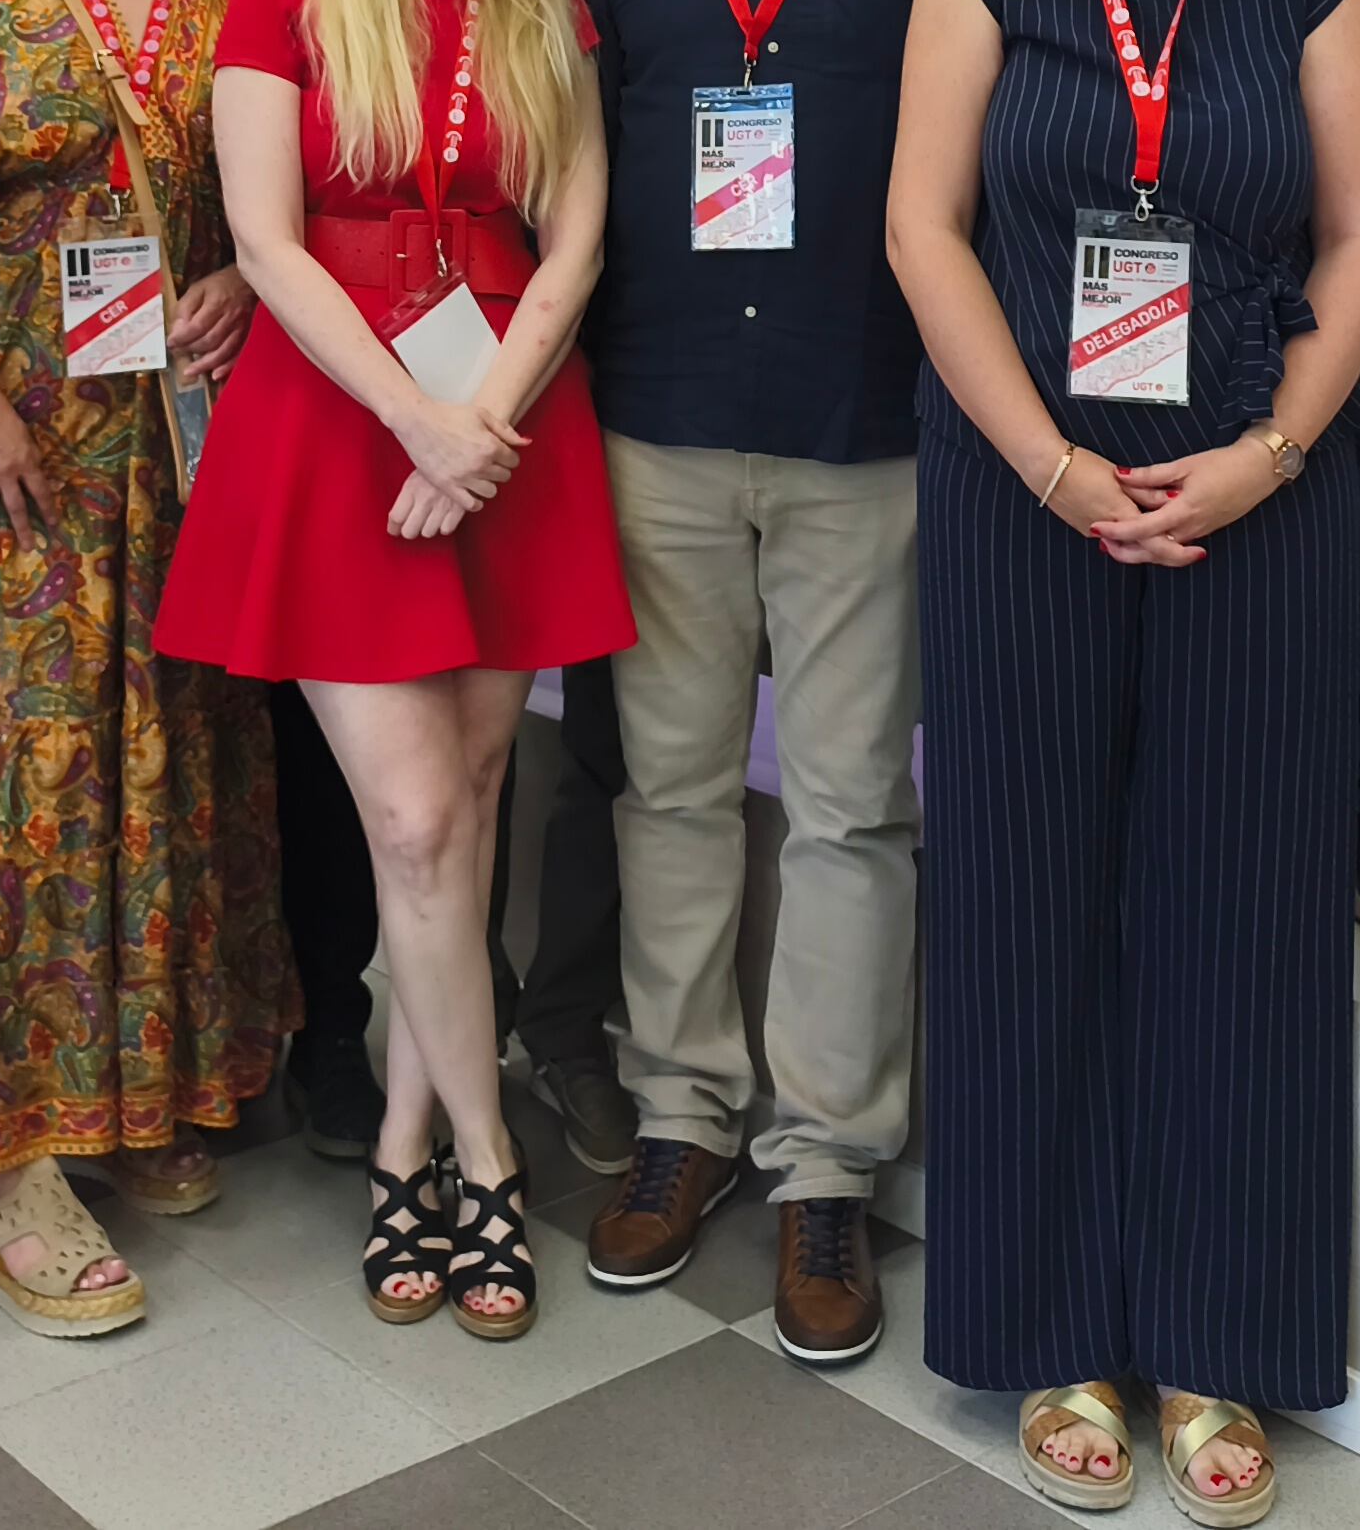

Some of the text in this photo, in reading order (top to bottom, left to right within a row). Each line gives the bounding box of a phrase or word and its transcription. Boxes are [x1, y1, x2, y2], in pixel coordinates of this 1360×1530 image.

[727, 117, 782, 128] CONGRESO
[728, 130, 752, 141] UGT
[702, 150, 724, 158] MÁS
[702, 160, 736, 169] MEJOR
[1113, 248, 1179, 261] CONGRESO
[93, 256, 119, 269] UGT
[1113, 260, 1143, 274] UGT
[1083, 281, 1109, 291] MÁS
[1082, 293, 1122, 305] MEJOR
[99, 299, 128, 324] CER
[1082, 296, 1180, 356] DELEGADO/A
[1132, 382, 1153, 392] UGT
